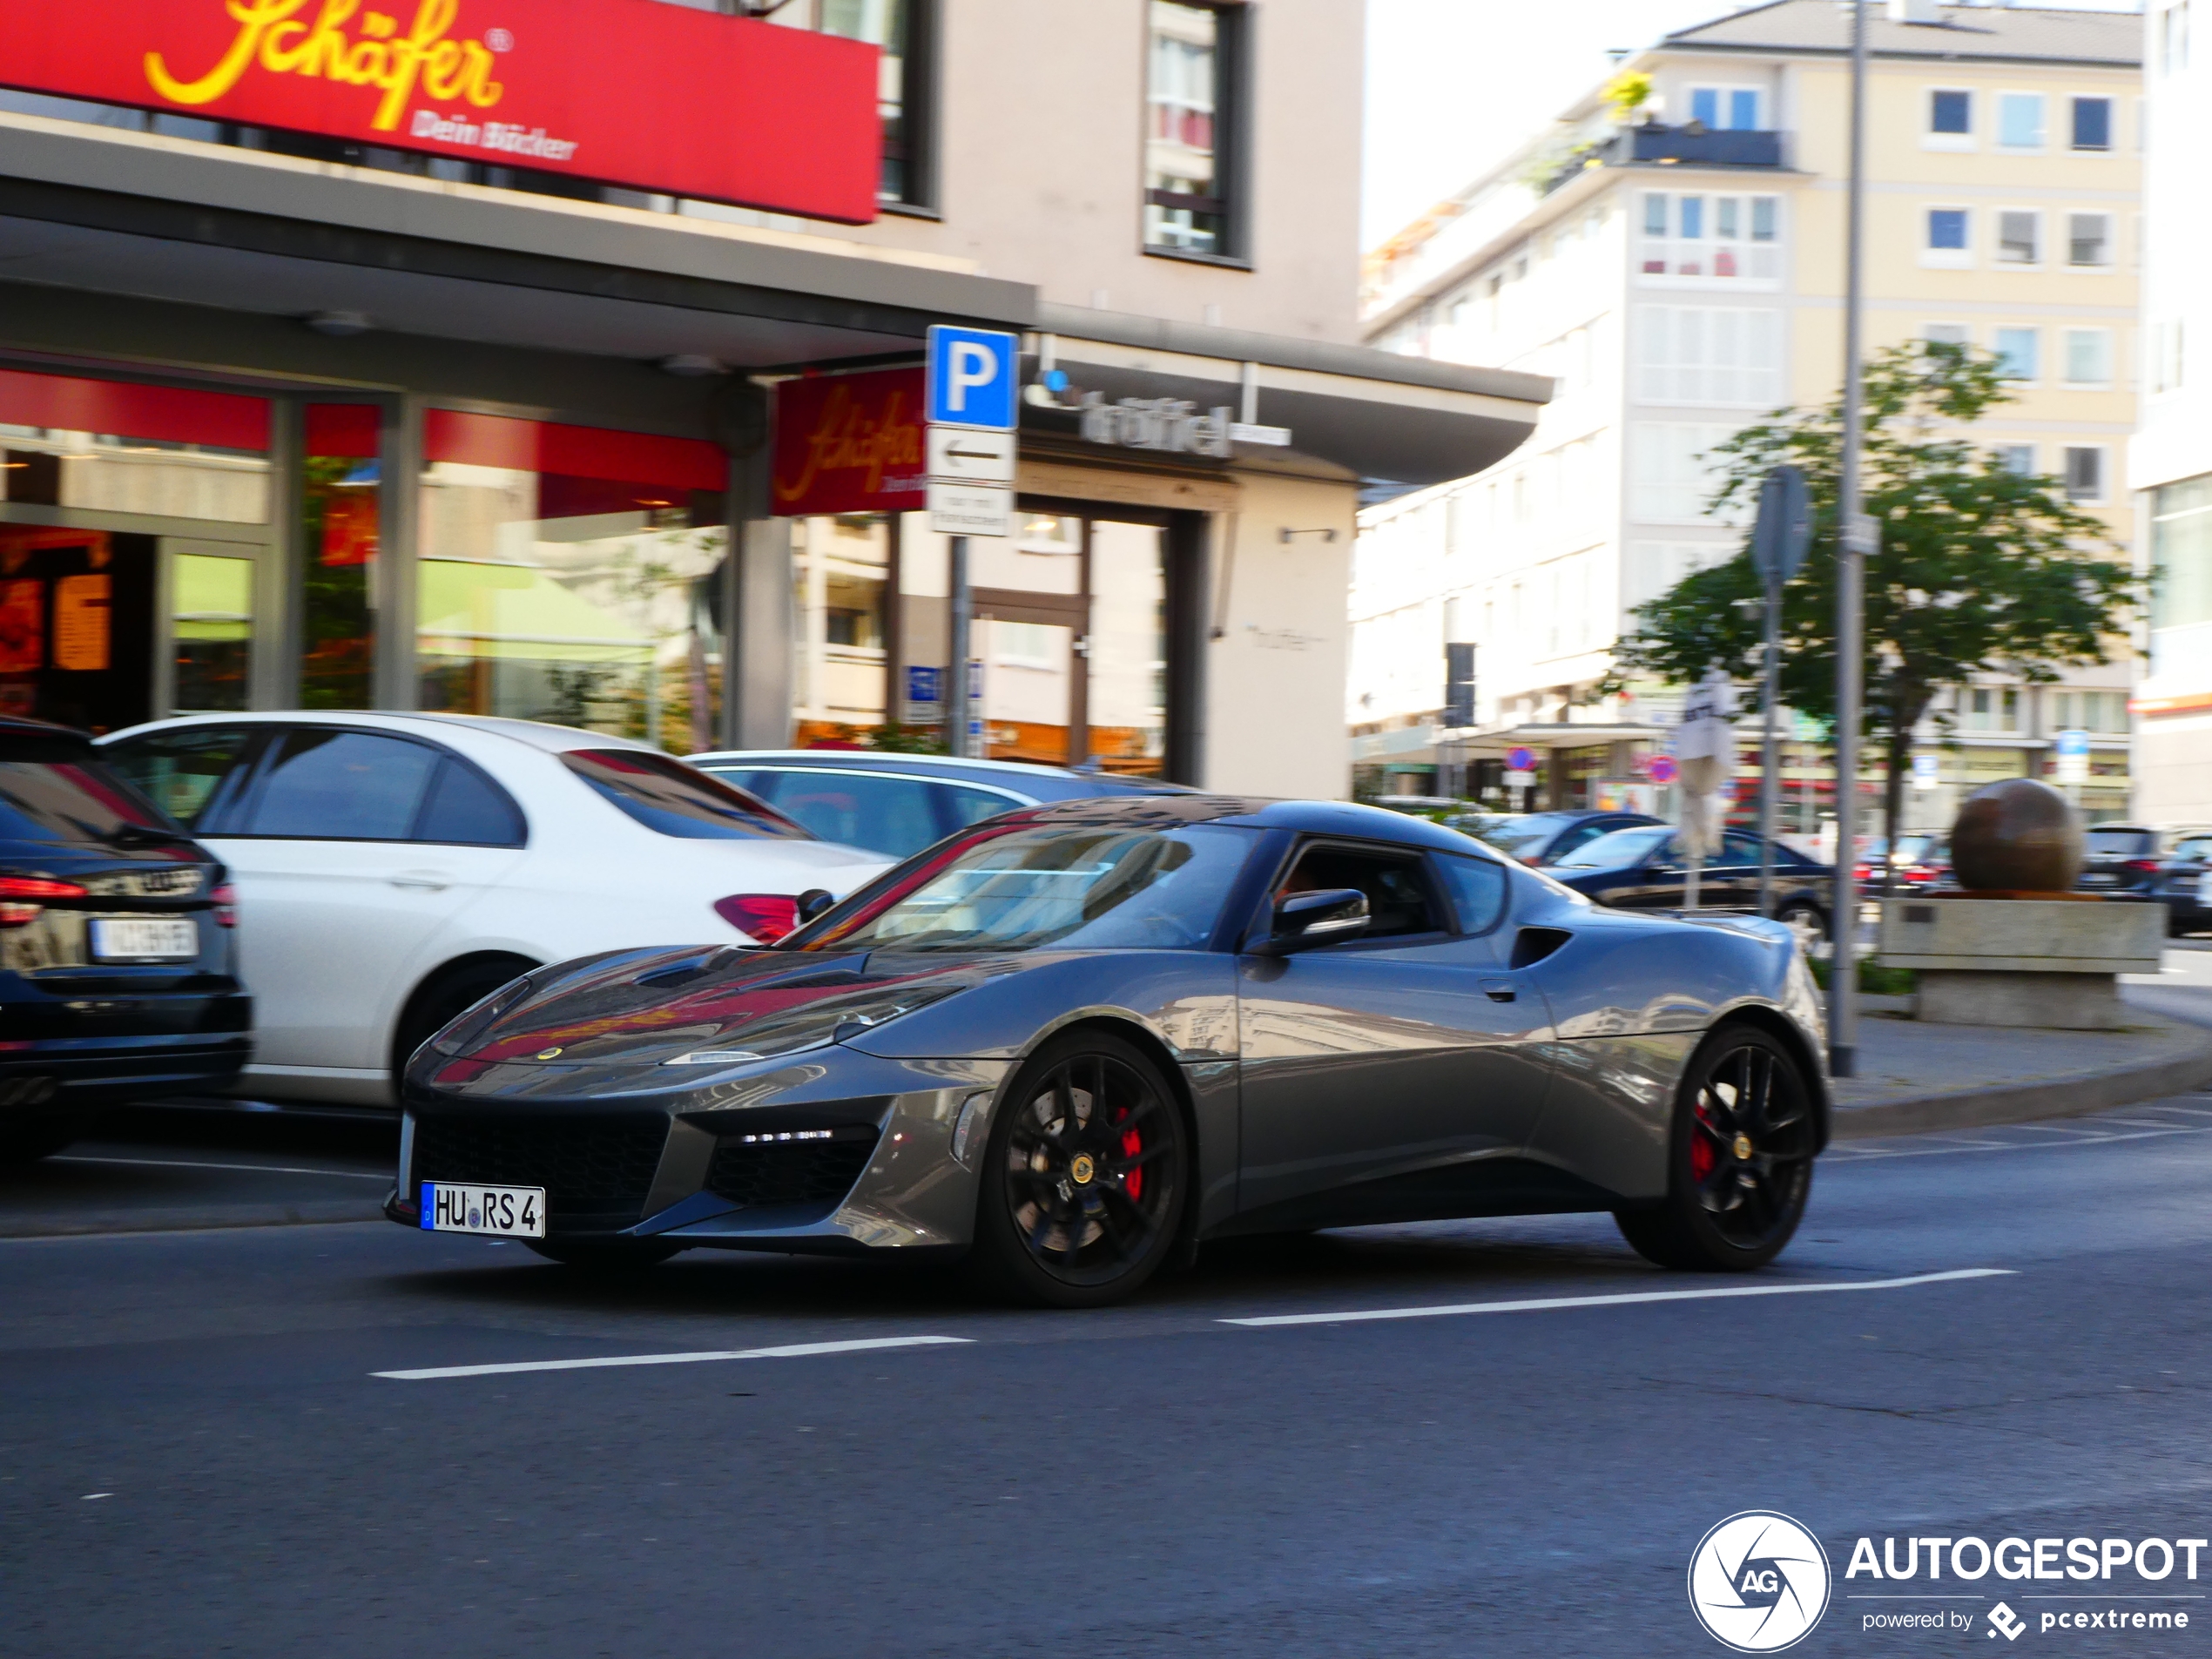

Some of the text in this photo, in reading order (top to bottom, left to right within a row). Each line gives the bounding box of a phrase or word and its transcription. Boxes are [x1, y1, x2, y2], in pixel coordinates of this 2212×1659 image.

[143, 0, 504, 132] Schäfer
[410, 109, 480, 145] Dein
[947, 341, 998, 411] P
[436, 1190, 536, 1231] HU RS 4
